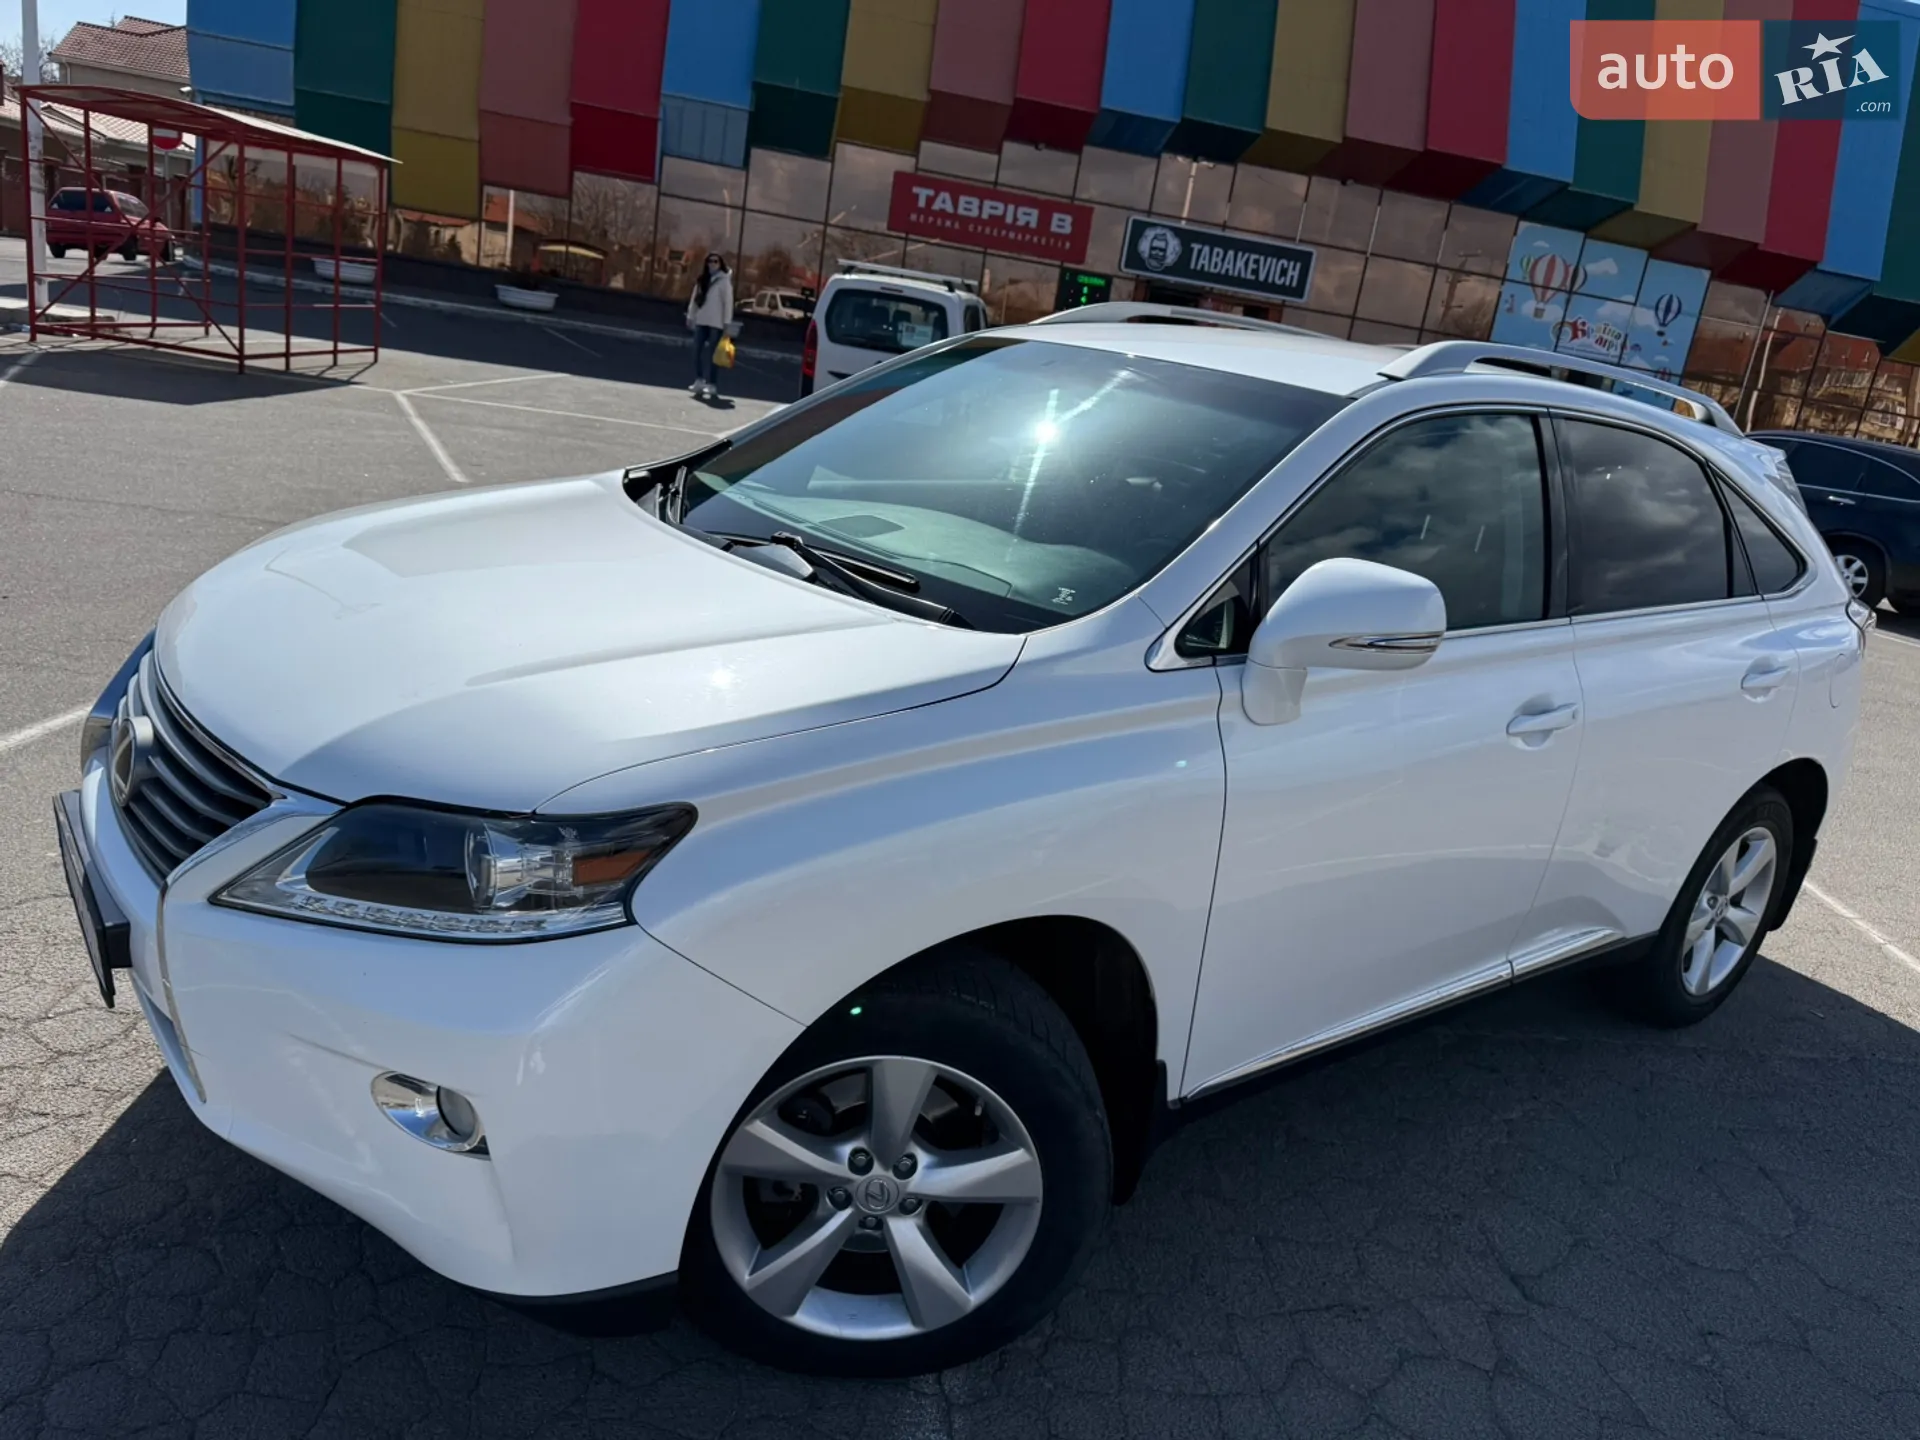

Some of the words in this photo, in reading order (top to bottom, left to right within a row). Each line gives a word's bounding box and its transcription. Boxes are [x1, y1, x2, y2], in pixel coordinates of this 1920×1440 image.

[912, 186, 1039, 229] ТАВРІЯ
[1050, 212, 1073, 235] В
[1190, 243, 1302, 288] TABAKEVICH
